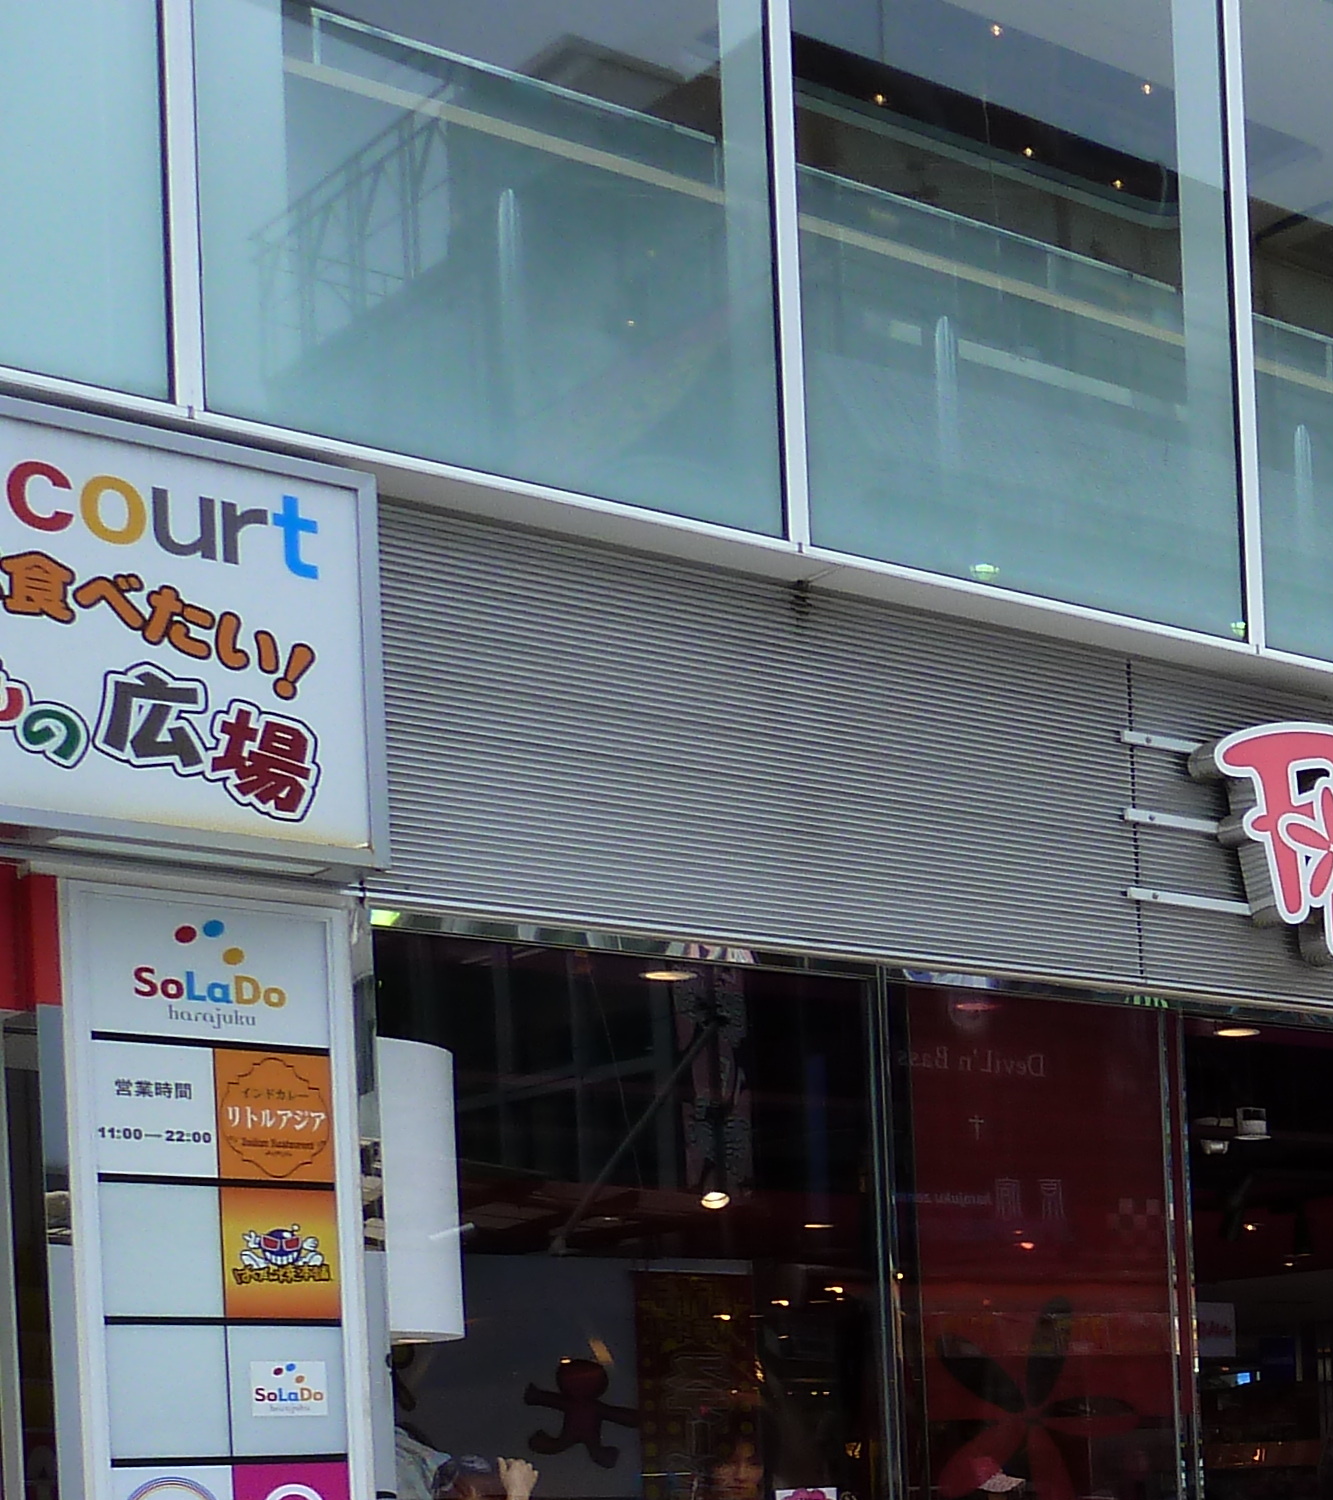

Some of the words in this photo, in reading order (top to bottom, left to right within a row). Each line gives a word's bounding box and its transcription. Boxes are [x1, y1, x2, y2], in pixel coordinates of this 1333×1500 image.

[133, 966, 288, 1010] SoLaDo
[168, 1004, 257, 1029] harajuku
[115, 1078, 192, 1101] 営業時間
[241, 1087, 309, 1101] インドカレー
[227, 1106, 326, 1133] リトルアジア
[254, 1387, 324, 1402] SoLaDo
